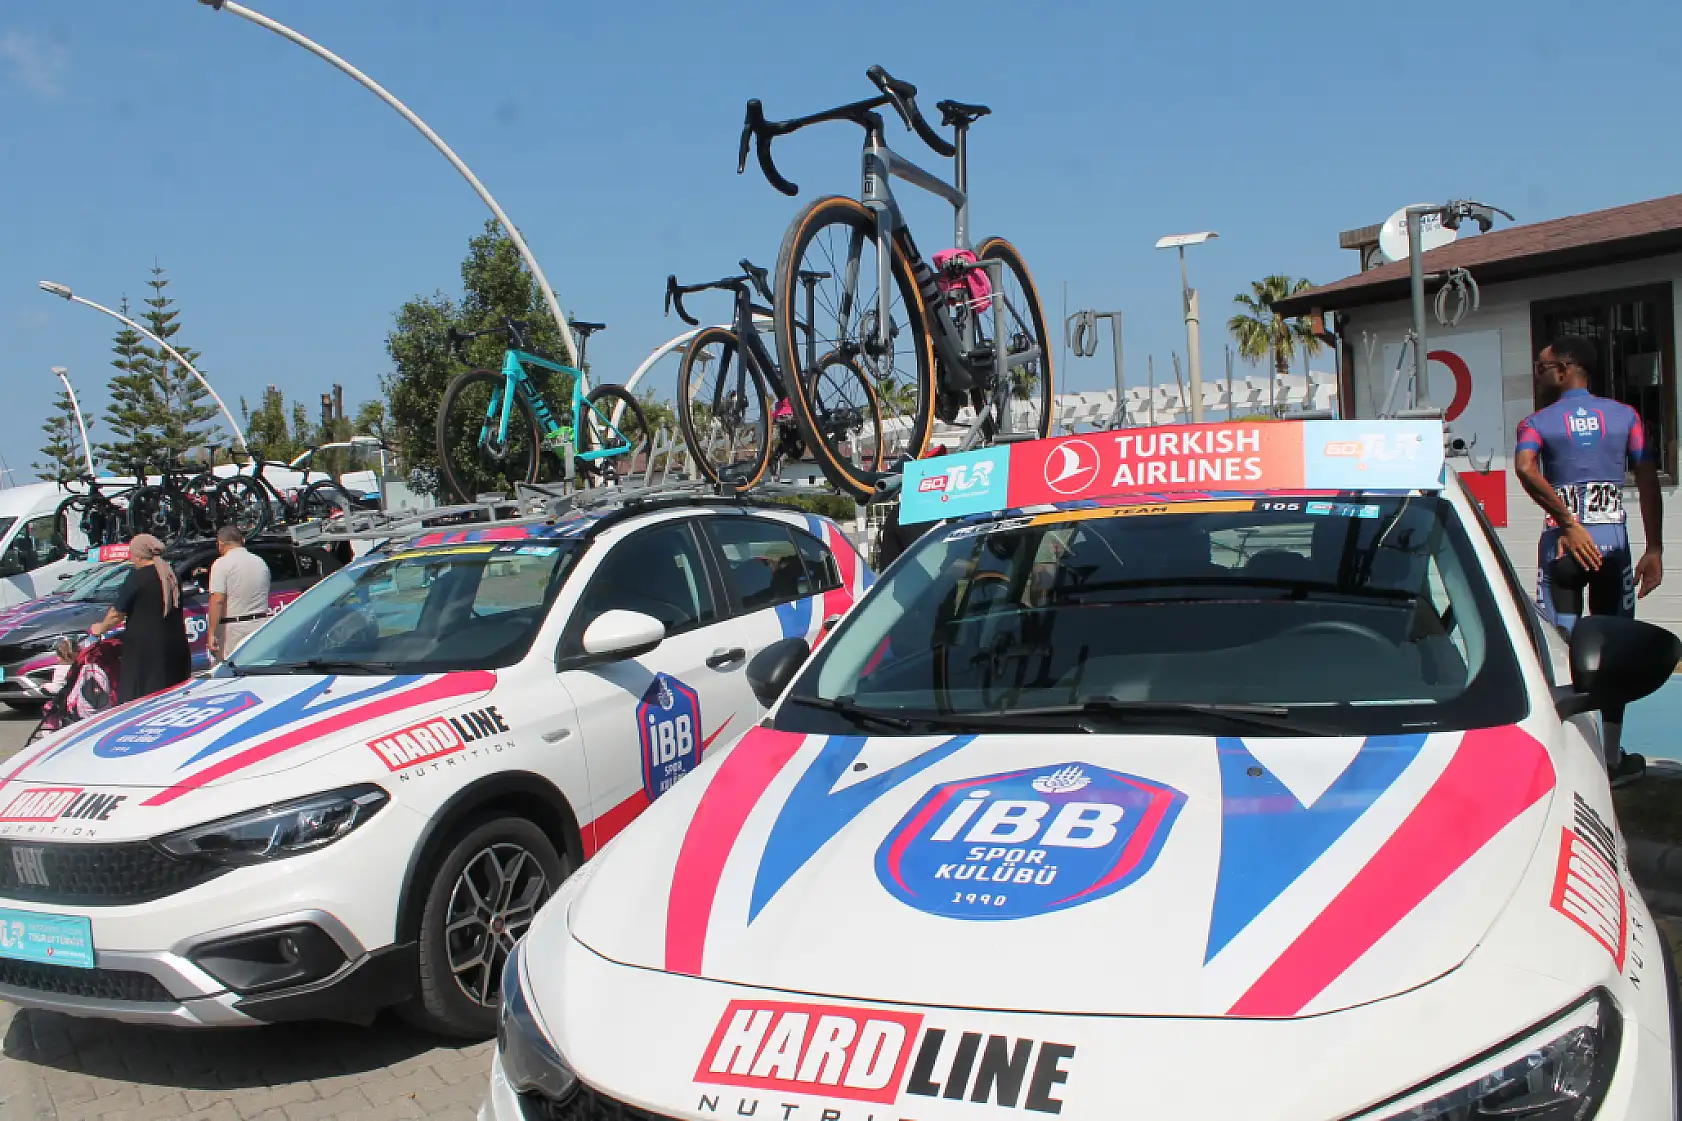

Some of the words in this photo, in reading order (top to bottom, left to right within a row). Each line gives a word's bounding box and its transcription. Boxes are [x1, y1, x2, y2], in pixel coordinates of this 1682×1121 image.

[1114, 429, 1260, 459] TURKISH
[1111, 457, 1263, 487] AIRLINES
[1112, 506, 1168, 516] TEAM
[399, 740, 517, 782] NUTRITION
[965, 846, 1047, 865] SPOR
[933, 862, 1059, 886] KULÜBÜ
[950, 891, 1008, 907] 1990
